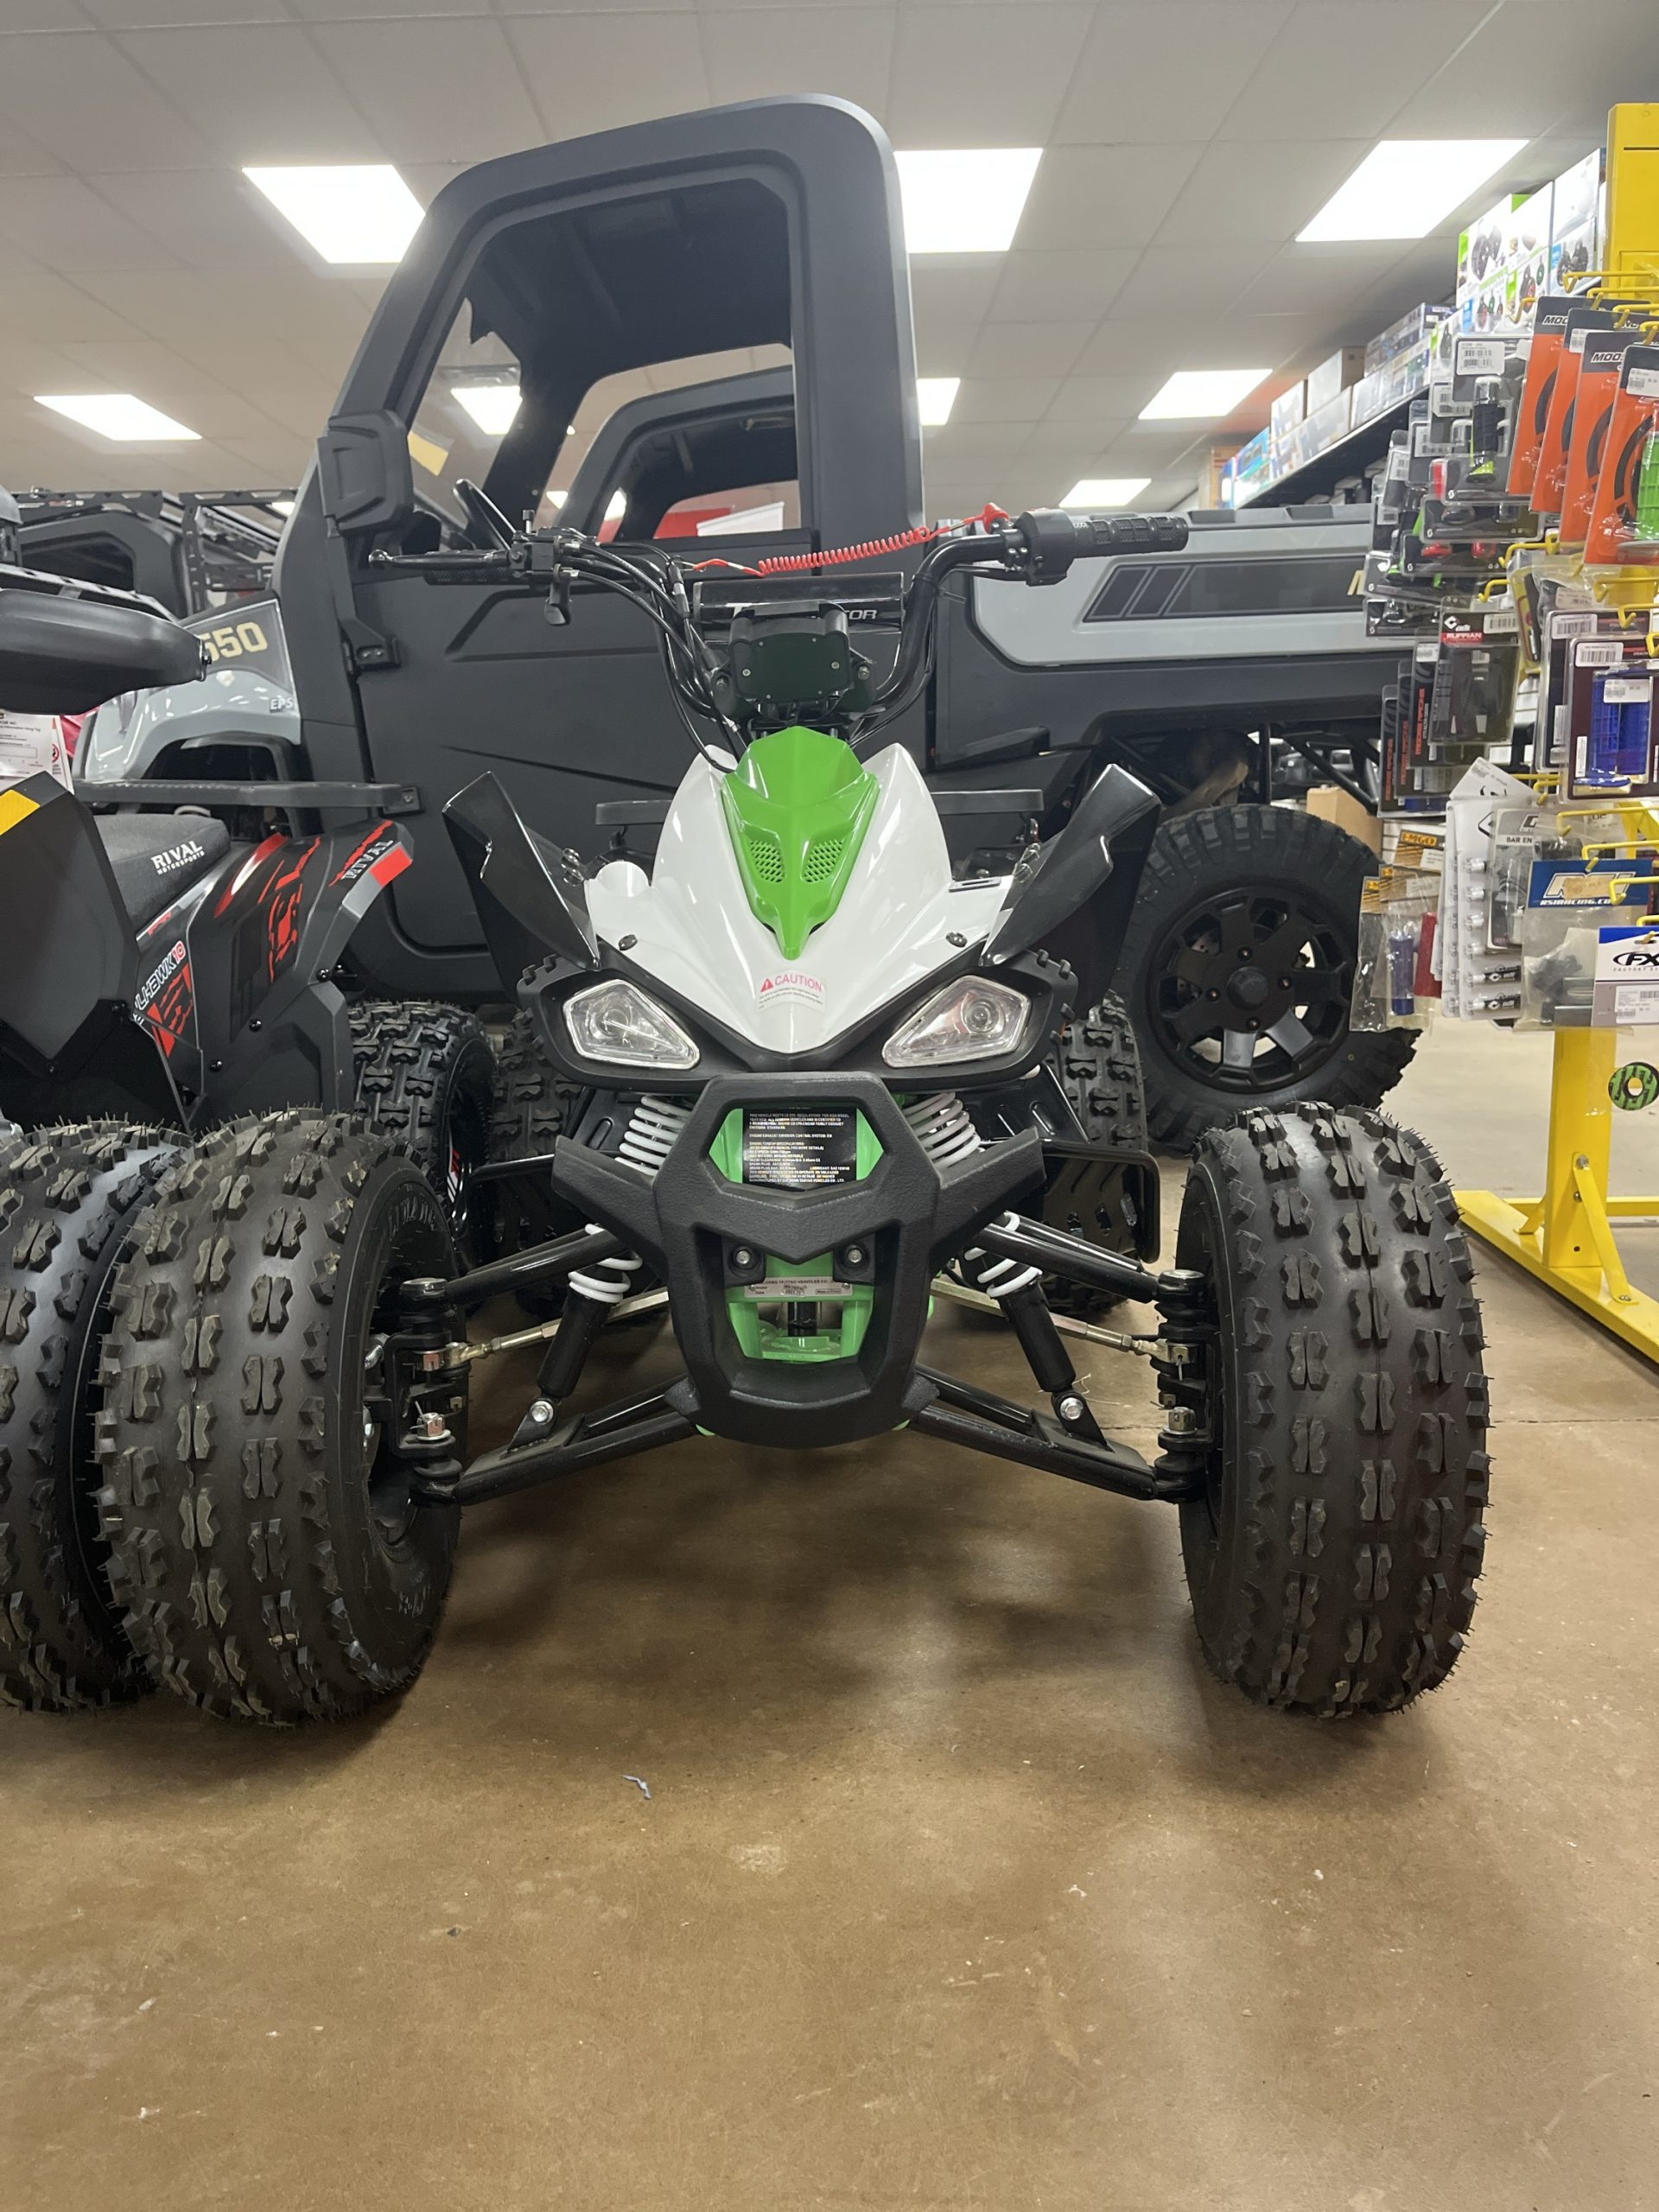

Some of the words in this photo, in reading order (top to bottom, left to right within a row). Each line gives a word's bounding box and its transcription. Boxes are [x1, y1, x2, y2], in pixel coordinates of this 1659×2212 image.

[270, 696, 294, 711] EPS
[151, 840, 203, 869] RIVAL
[156, 850, 205, 875] MOTORSPORTS
[340, 840, 394, 880] RIVAL
[774, 974, 822, 993] CAUTION
